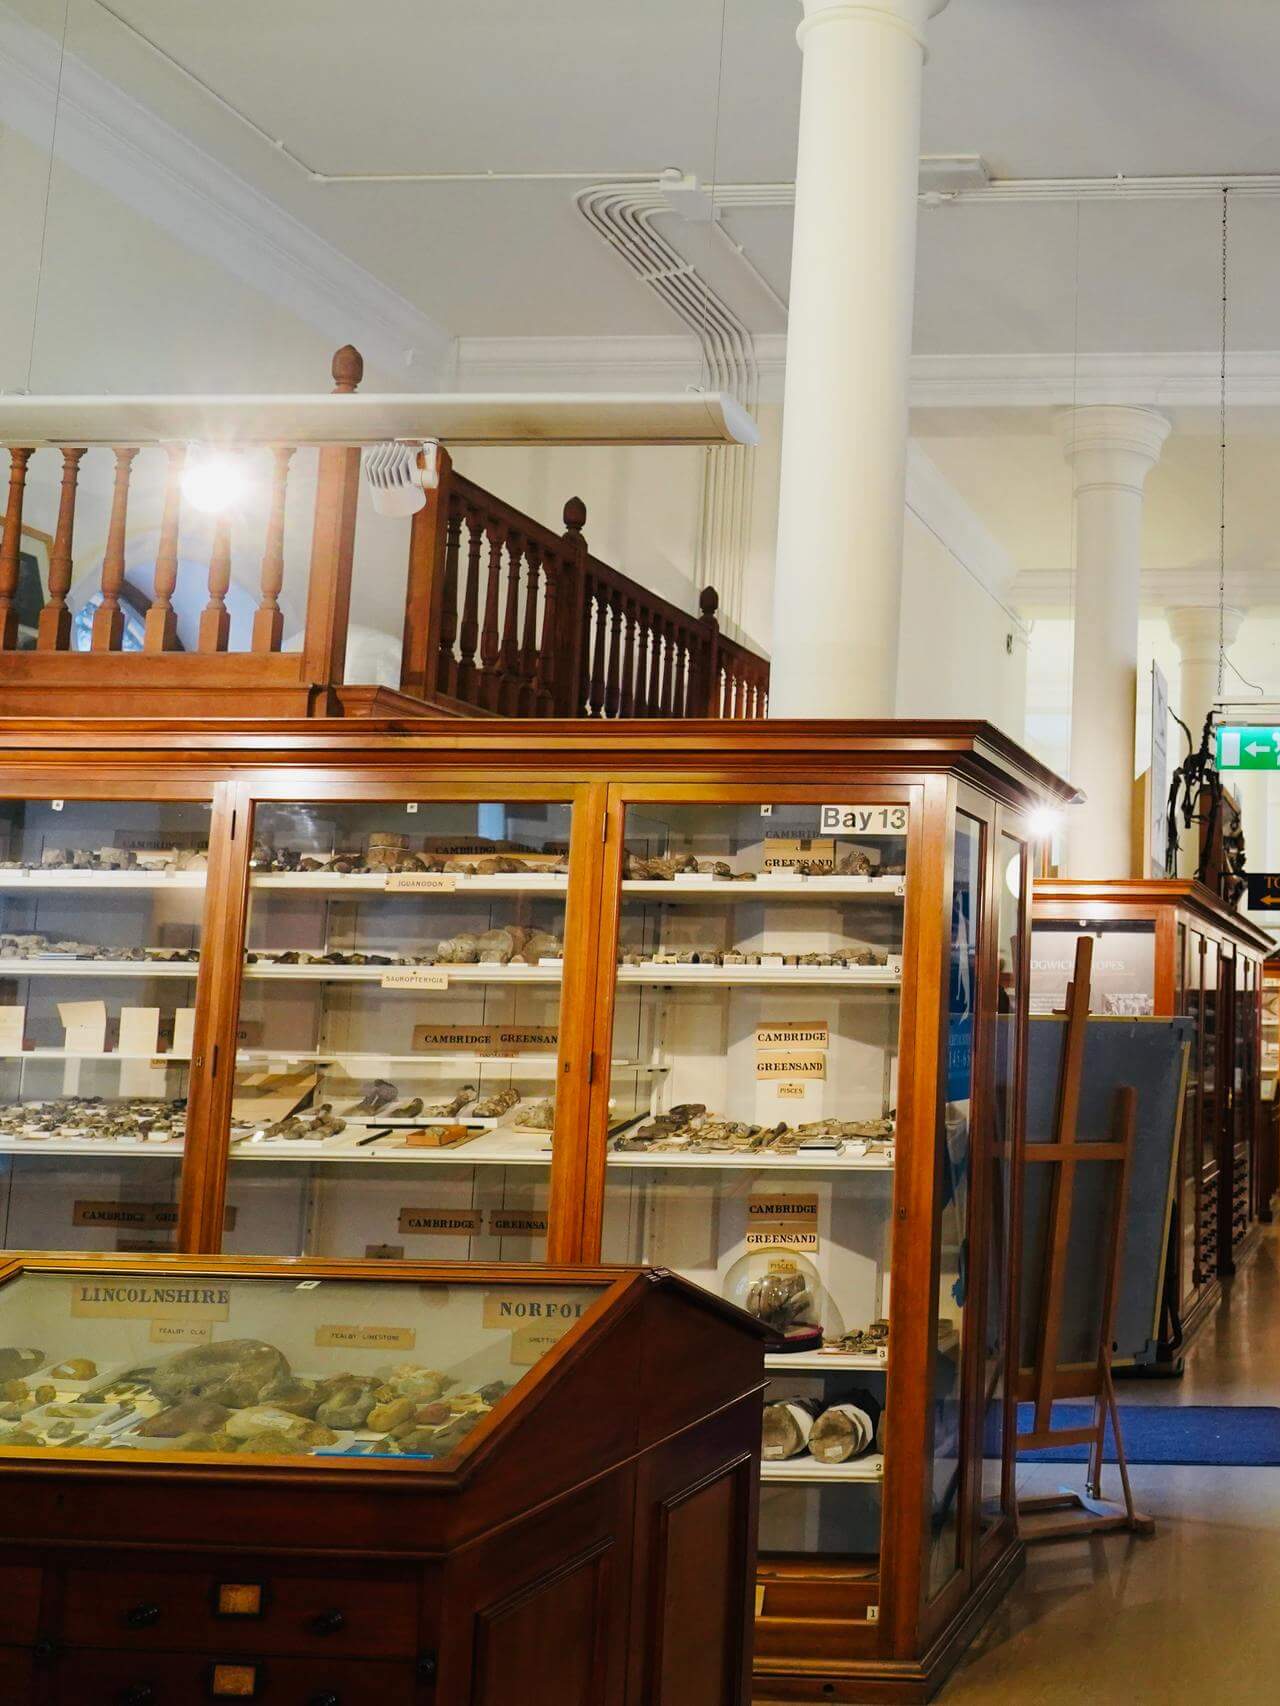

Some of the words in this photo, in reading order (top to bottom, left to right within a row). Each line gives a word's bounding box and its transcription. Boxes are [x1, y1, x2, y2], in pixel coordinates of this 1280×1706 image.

[823, 808, 872, 831] Bay
[878, 808, 906, 830] 13
[894, 965, 901, 974] 5
[424, 1034, 492, 1044] CAMBRIDGE
[757, 1032, 826, 1042] CAMBRIDGE
[757, 1062, 823, 1071] GREENSAND
[750, 1204, 817, 1214] CAMBRIDGE
[408, 1219, 475, 1229] CAMBRIDGE
[746, 1234, 816, 1244] GREENSAND
[80, 1286, 230, 1305] LINCOLNSHIRE
[875, 1463, 882, 1472] 2
[870, 1609, 876, 1618] 1
